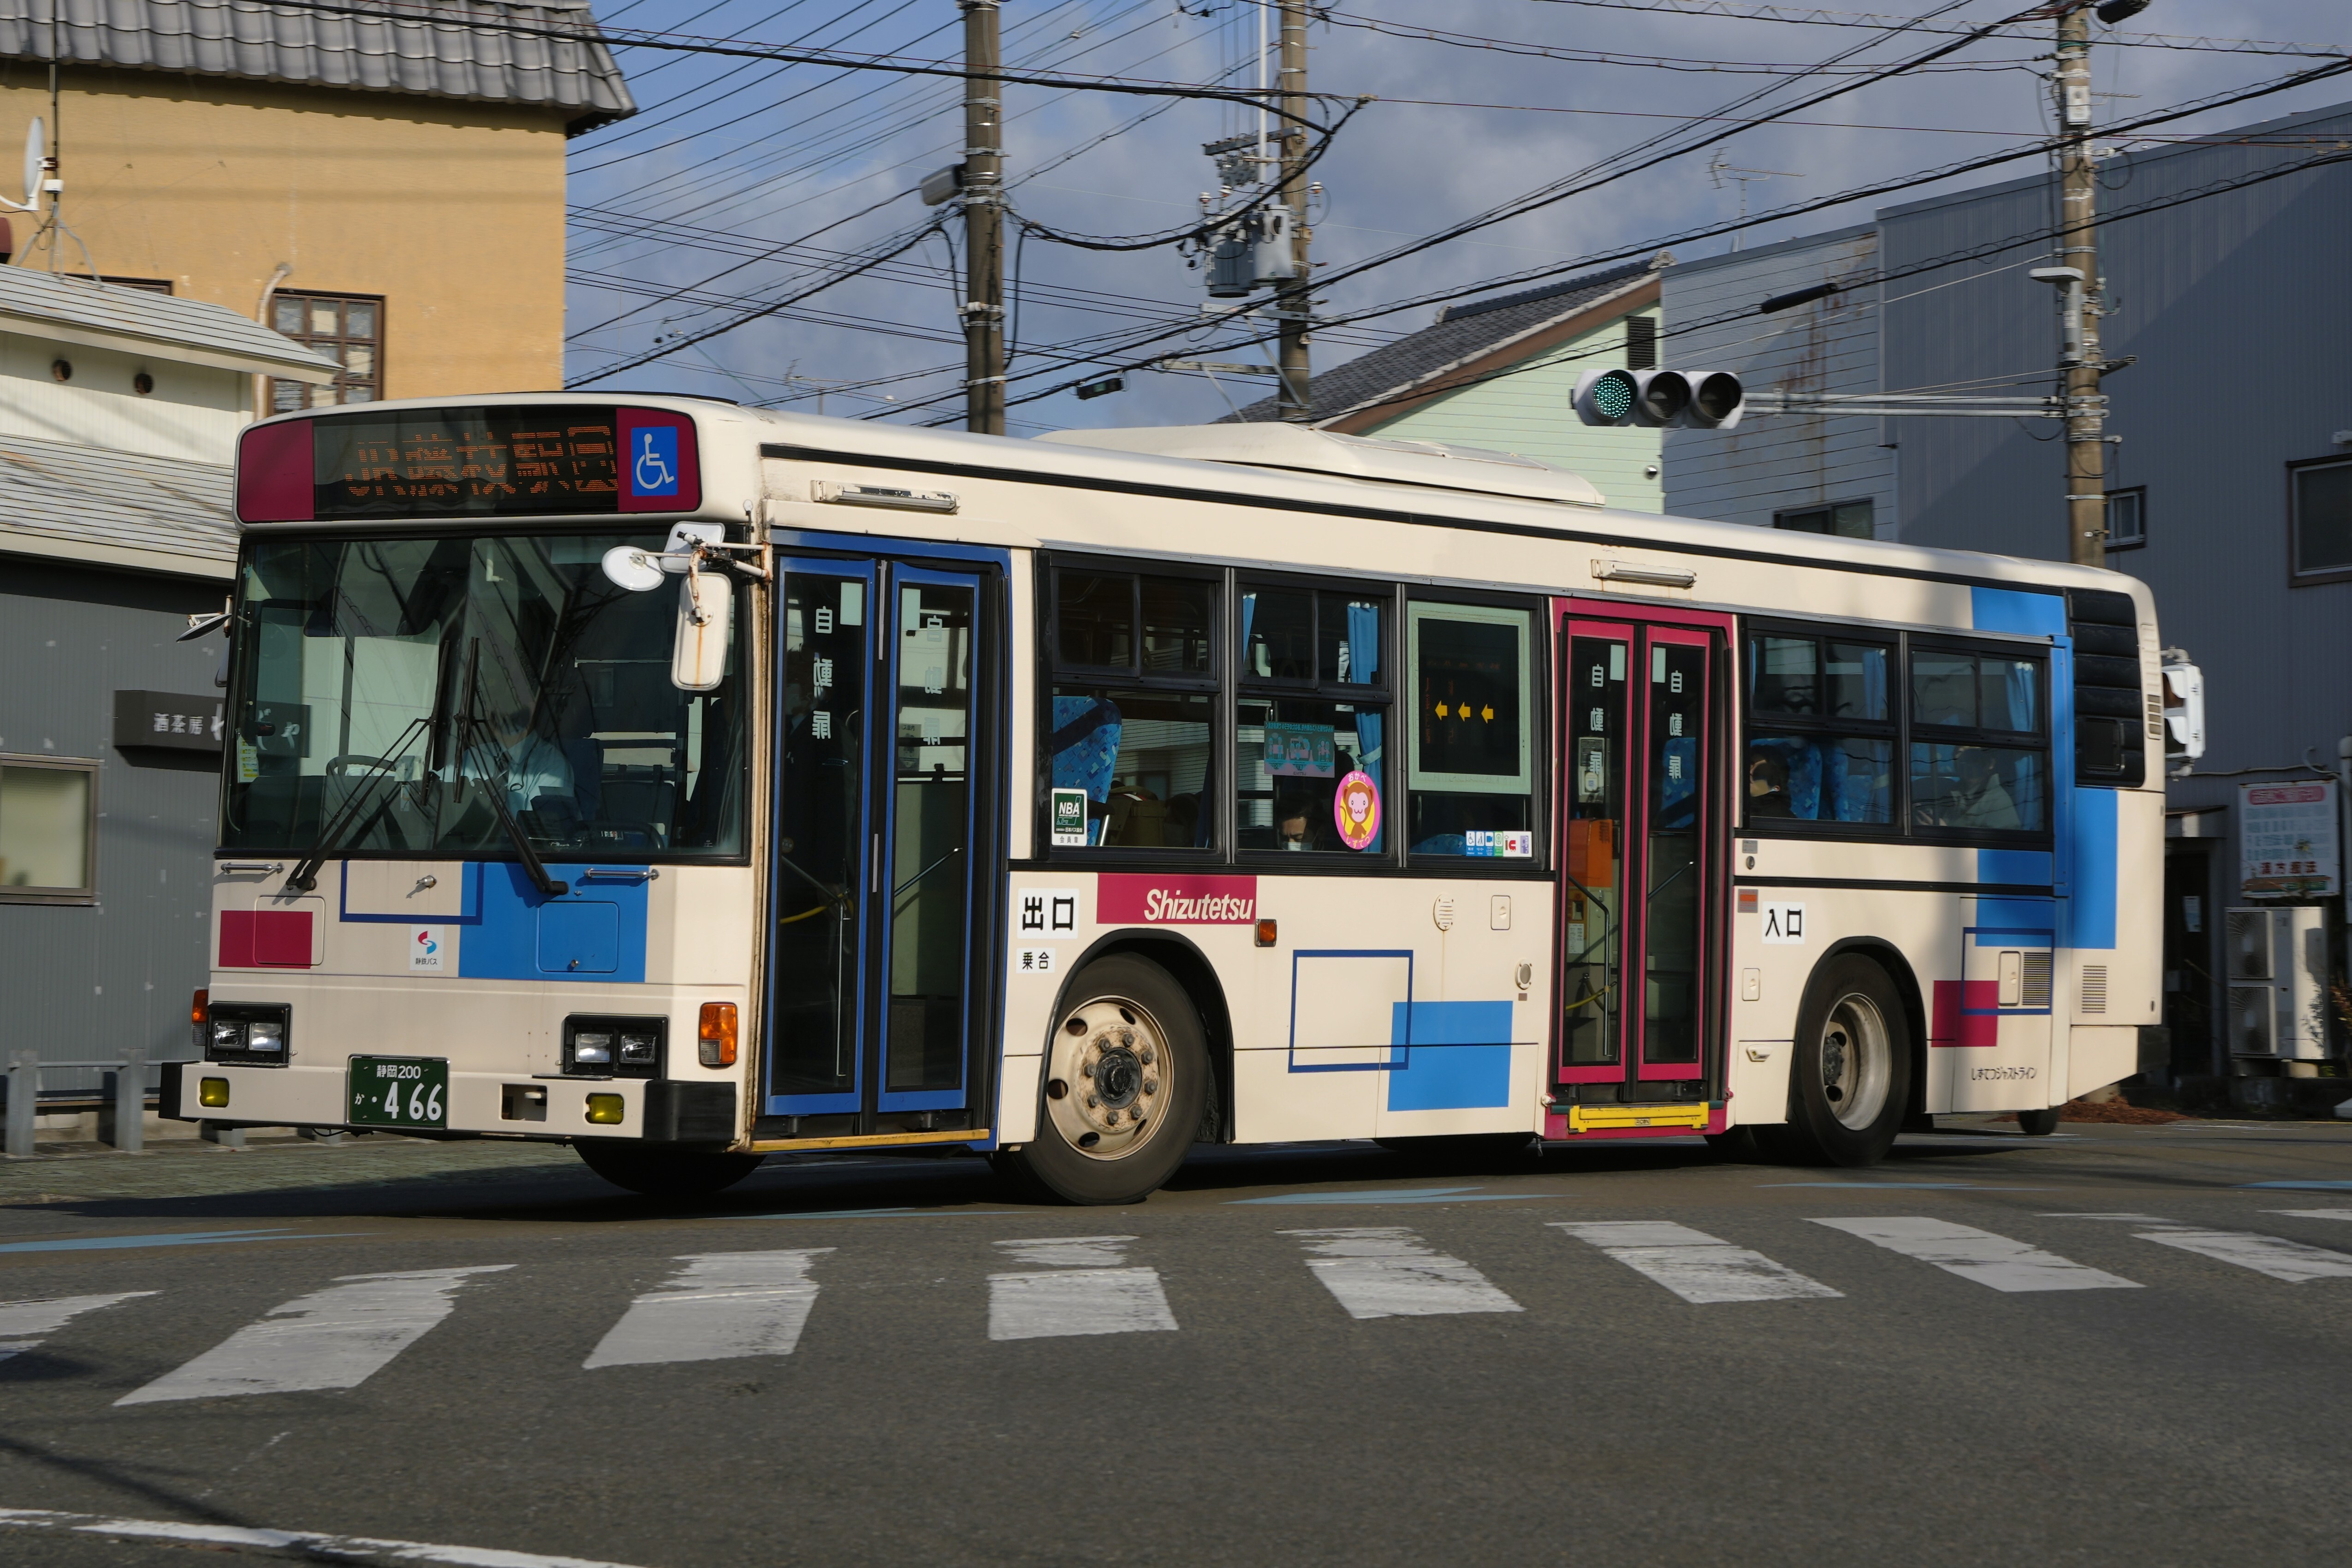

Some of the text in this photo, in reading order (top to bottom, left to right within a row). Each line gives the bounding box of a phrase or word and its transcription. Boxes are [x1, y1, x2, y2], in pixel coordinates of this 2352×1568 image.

[1348, 772, 1367, 783] おかべ
[1058, 802, 1080, 815] NBA
[1346, 836, 1371, 848] しずてつ
[1144, 889, 1253, 921] Shizutetsu
[1022, 896, 1074, 931] 出口
[1765, 909, 1802, 938] 入口
[1022, 951, 1049, 969] 乗合
[354, 1093, 365, 1105] か
